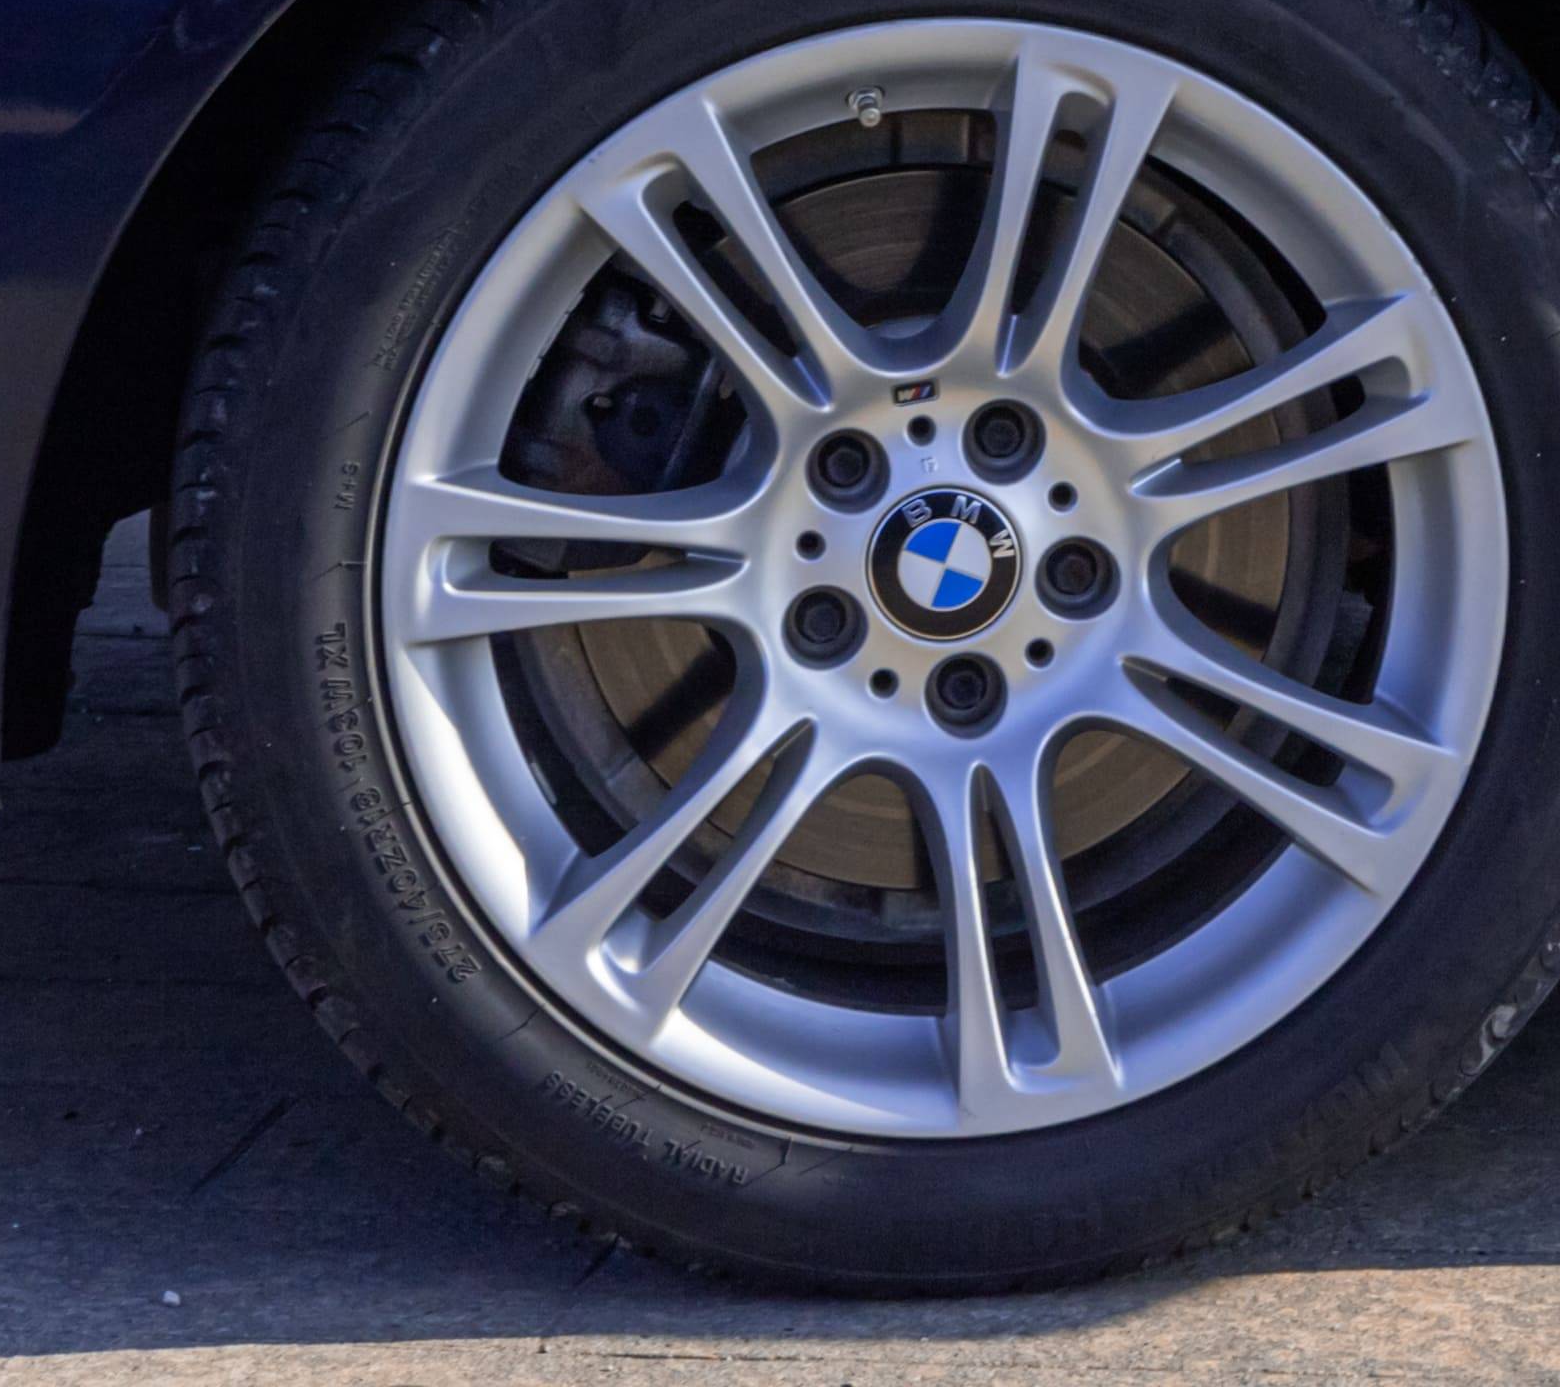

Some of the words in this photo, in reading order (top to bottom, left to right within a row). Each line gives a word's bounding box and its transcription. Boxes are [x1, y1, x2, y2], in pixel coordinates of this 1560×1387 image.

[904, 496, 1016, 558] BMW
[314, 622, 350, 672] XL
[348, 784, 483, 985] 275/40ZR18
[544, 1069, 655, 1148] TUBELESS
[660, 1139, 748, 1187] RADIAL
